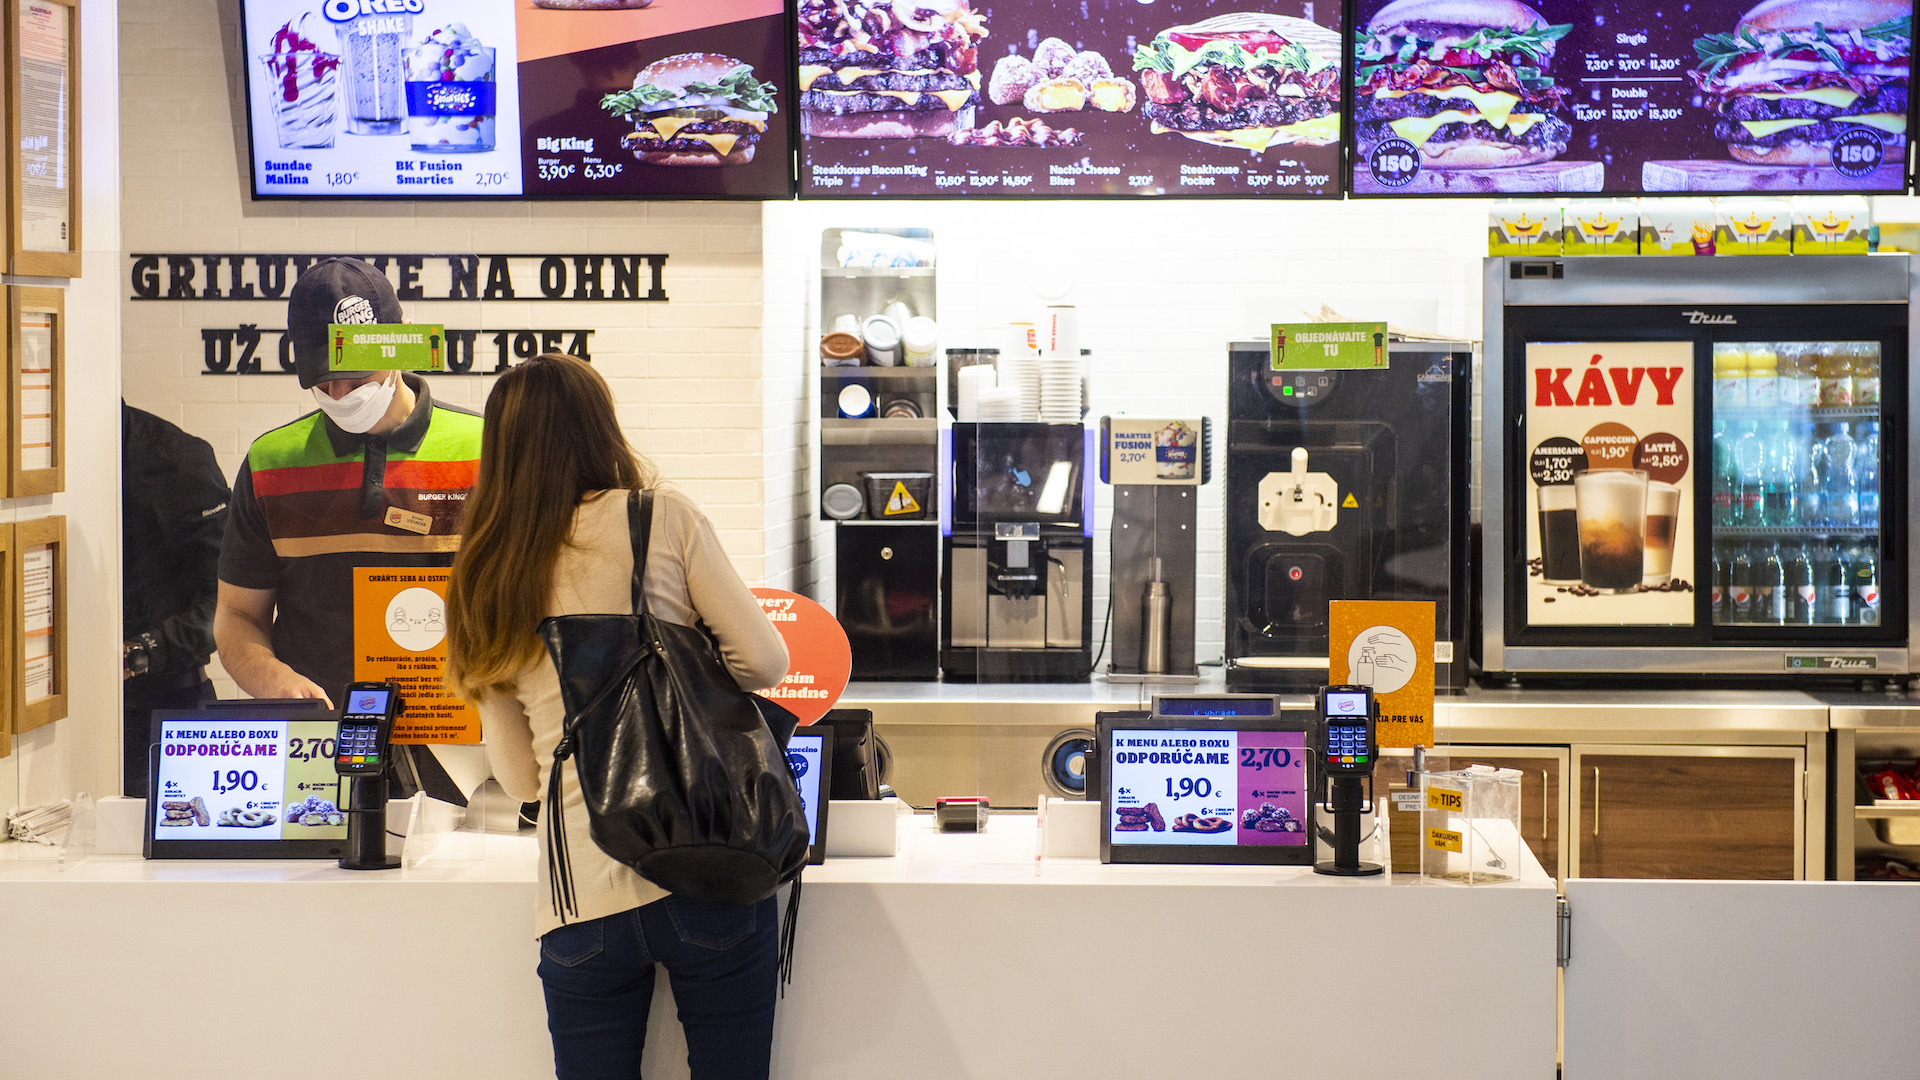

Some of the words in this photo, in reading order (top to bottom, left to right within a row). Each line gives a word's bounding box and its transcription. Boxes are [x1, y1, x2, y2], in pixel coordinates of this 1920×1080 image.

[358, 17, 404, 36] SHAKE
[1616, 33, 1648, 46] Single
[1611, 87, 1648, 98] Double
[537, 138, 560, 154] Big
[561, 138, 594, 154] King
[1840, 144, 1876, 163] 150
[264, 160, 312, 171] Sundae
[396, 160, 414, 171] BK
[420, 160, 462, 171] Fusion
[538, 157, 560, 166] Burger
[583, 156, 602, 164] Menu
[1378, 154, 1414, 172] 150
[538, 164, 576, 181] 3,90€
[584, 163, 623, 181] 6,30€
[812, 165, 870, 176] Steakhouse
[871, 165, 903, 176] Bacon
[904, 165, 928, 177] King
[1050, 166, 1082, 175] Nacho
[1082, 166, 1120, 175] Cheese
[1180, 166, 1240, 175] Steakhouse
[266, 174, 309, 185] Malina
[326, 172, 360, 186] 1,80€
[396, 174, 454, 185] Smarties
[476, 172, 510, 186] 2,70€
[813, 176, 843, 187] Triple
[970, 176, 1000, 188] 12,90€
[1050, 176, 1076, 186] Bites
[1128, 176, 1154, 187] 2,70€
[1180, 176, 1215, 186] Pocket
[131, 254, 424, 300] GRILUE
[449, 254, 515, 300] NA
[540, 254, 670, 300] OHNI
[338, 300, 371, 321] BURGER
[353, 332, 424, 344] OBJEDNÁVAJTE
[1295, 331, 1367, 344] OBJEDNÁVAJTE
[202, 324, 262, 375] UŽ
[380, 346, 396, 358] TU
[1323, 344, 1339, 356] TU
[1535, 354, 1684, 406] KÁVY
[1115, 442, 1152, 450] FUSION
[1584, 436, 1637, 444] CAPPUCCINO
[1534, 446, 1584, 456] AMERICANO
[1644, 441, 1677, 452] LATTÉ
[1120, 453, 1146, 462] 2,70€
[1602, 446, 1630, 460] 1,90€
[1544, 457, 1572, 470] 1,70€
[1651, 453, 1684, 468] 2,50€
[1542, 469, 1574, 483] 2,30€
[368, 574, 398, 582] CHRÁŇTE
[1409, 714, 1424, 723] VÁS
[166, 730, 174, 739] K
[176, 730, 207, 739] MENU
[210, 730, 246, 739] ALEBO
[248, 730, 278, 739] BOXU
[165, 740, 278, 756] ODPORÚČAME
[1116, 739, 1124, 747] K
[1127, 739, 1158, 747] MENU
[1160, 739, 1198, 747] ALEBO
[1200, 739, 1230, 747] BOXU
[289, 738, 336, 763] 2,70
[1116, 749, 1230, 765] ODPORÚČAME
[1241, 748, 1291, 770] 2,70
[1294, 760, 1301, 768] €
[212, 770, 258, 794] 1,90
[1166, 777, 1212, 801] 1,90
[1215, 790, 1222, 798] €
[1440, 794, 1462, 808] TIPS
[1432, 830, 1459, 842] ĎAKUJEME
[1434, 840, 1446, 848] VÁM
